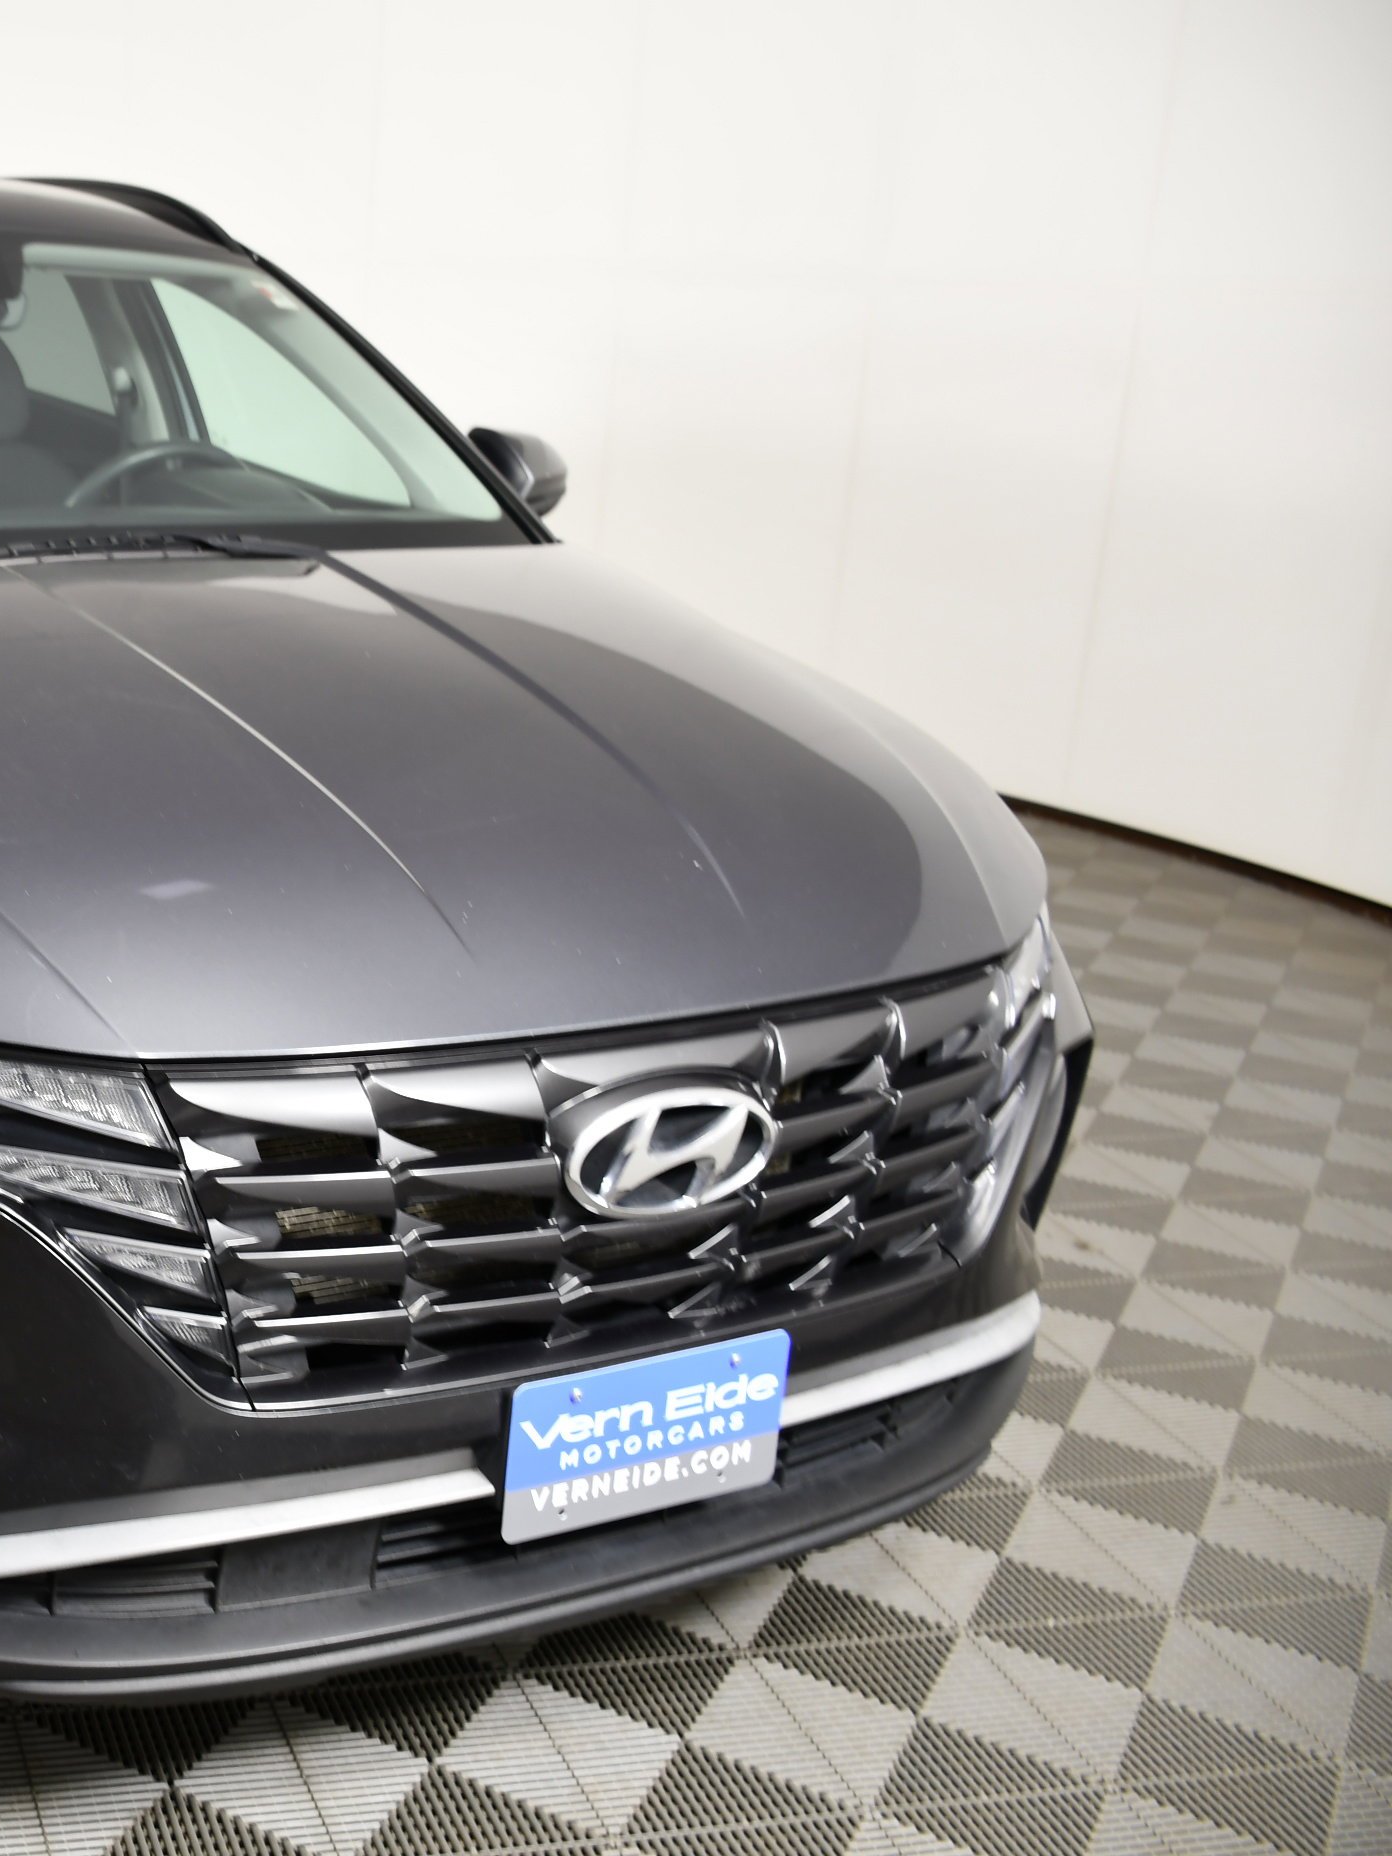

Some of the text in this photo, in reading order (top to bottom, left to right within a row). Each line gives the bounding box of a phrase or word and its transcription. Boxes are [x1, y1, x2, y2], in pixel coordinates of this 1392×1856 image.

[519, 1372, 779, 1450] Vern Eide
[559, 1411, 745, 1471] MOTORCARS
[530, 1439, 752, 1512] VERNEIDE.COM
